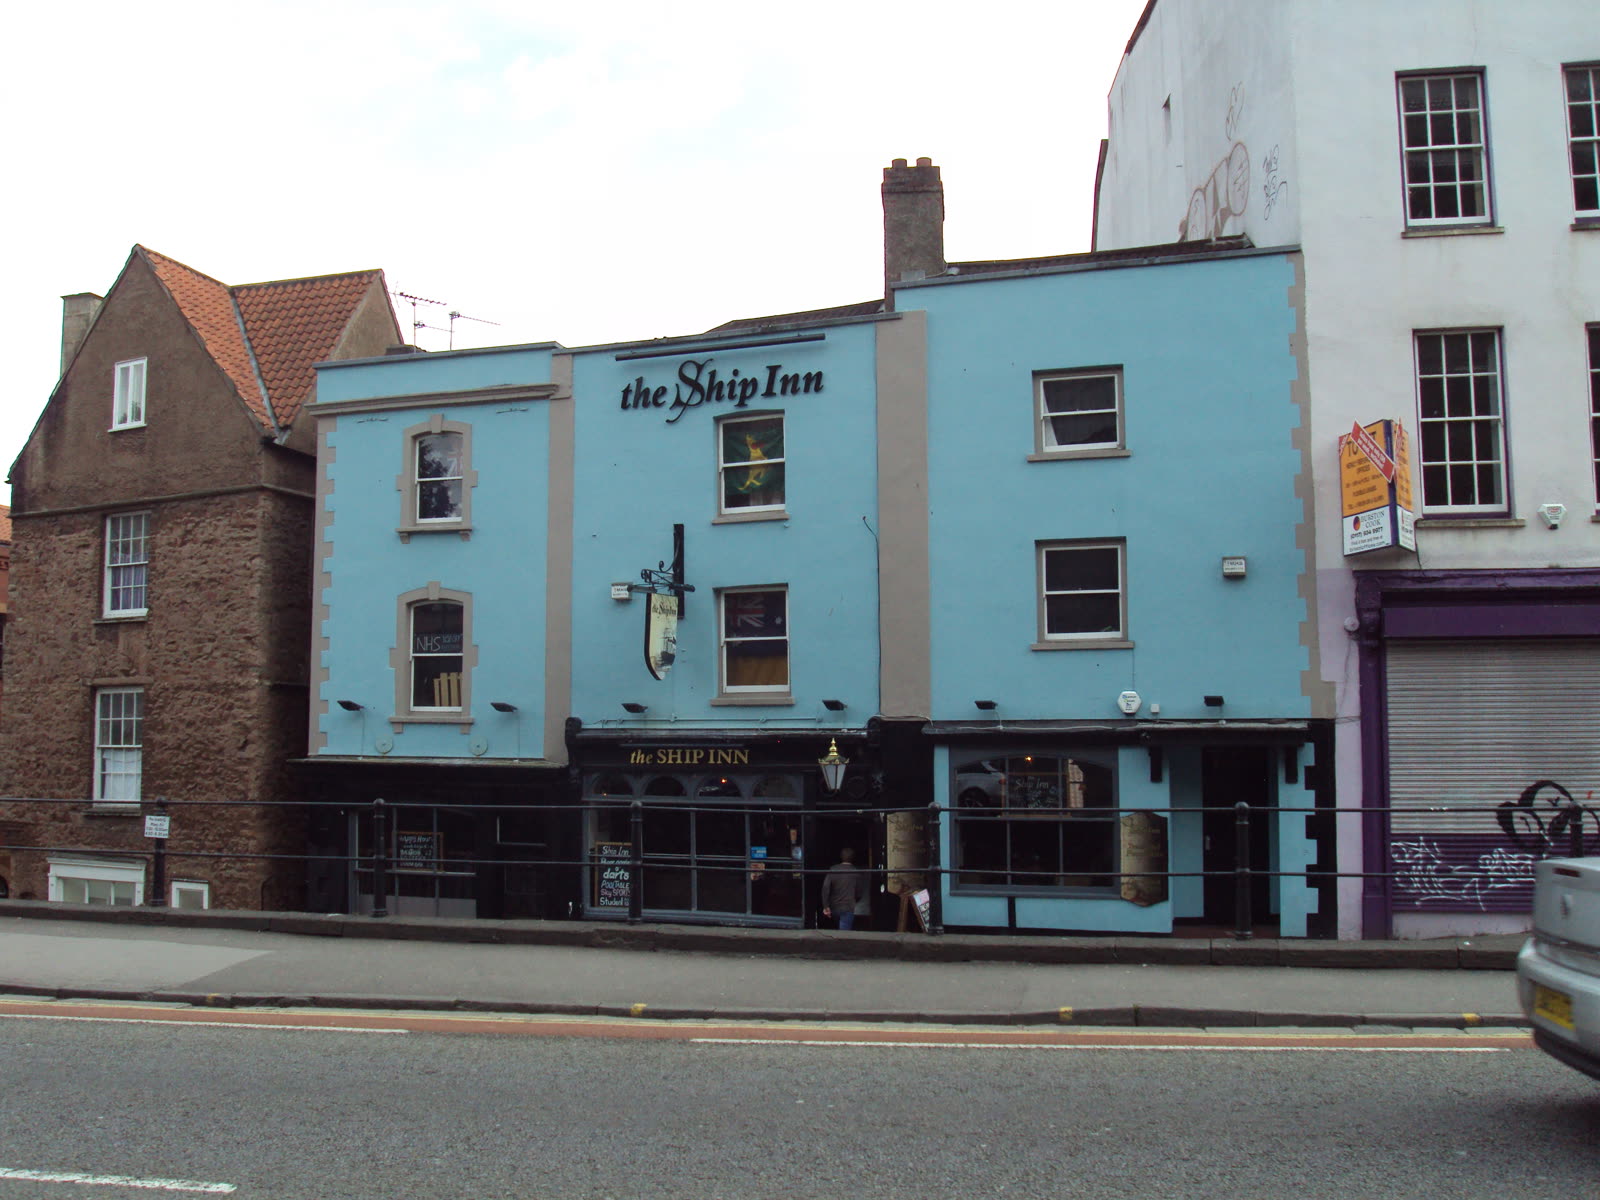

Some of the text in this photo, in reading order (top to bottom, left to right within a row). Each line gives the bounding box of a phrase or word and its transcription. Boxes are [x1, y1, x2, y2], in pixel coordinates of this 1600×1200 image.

[620, 358, 824, 423] the Ship Inn
[416, 636, 441, 651] NHS
[630, 749, 749, 764] the SHIP INN
[603, 867, 630, 880] darts
